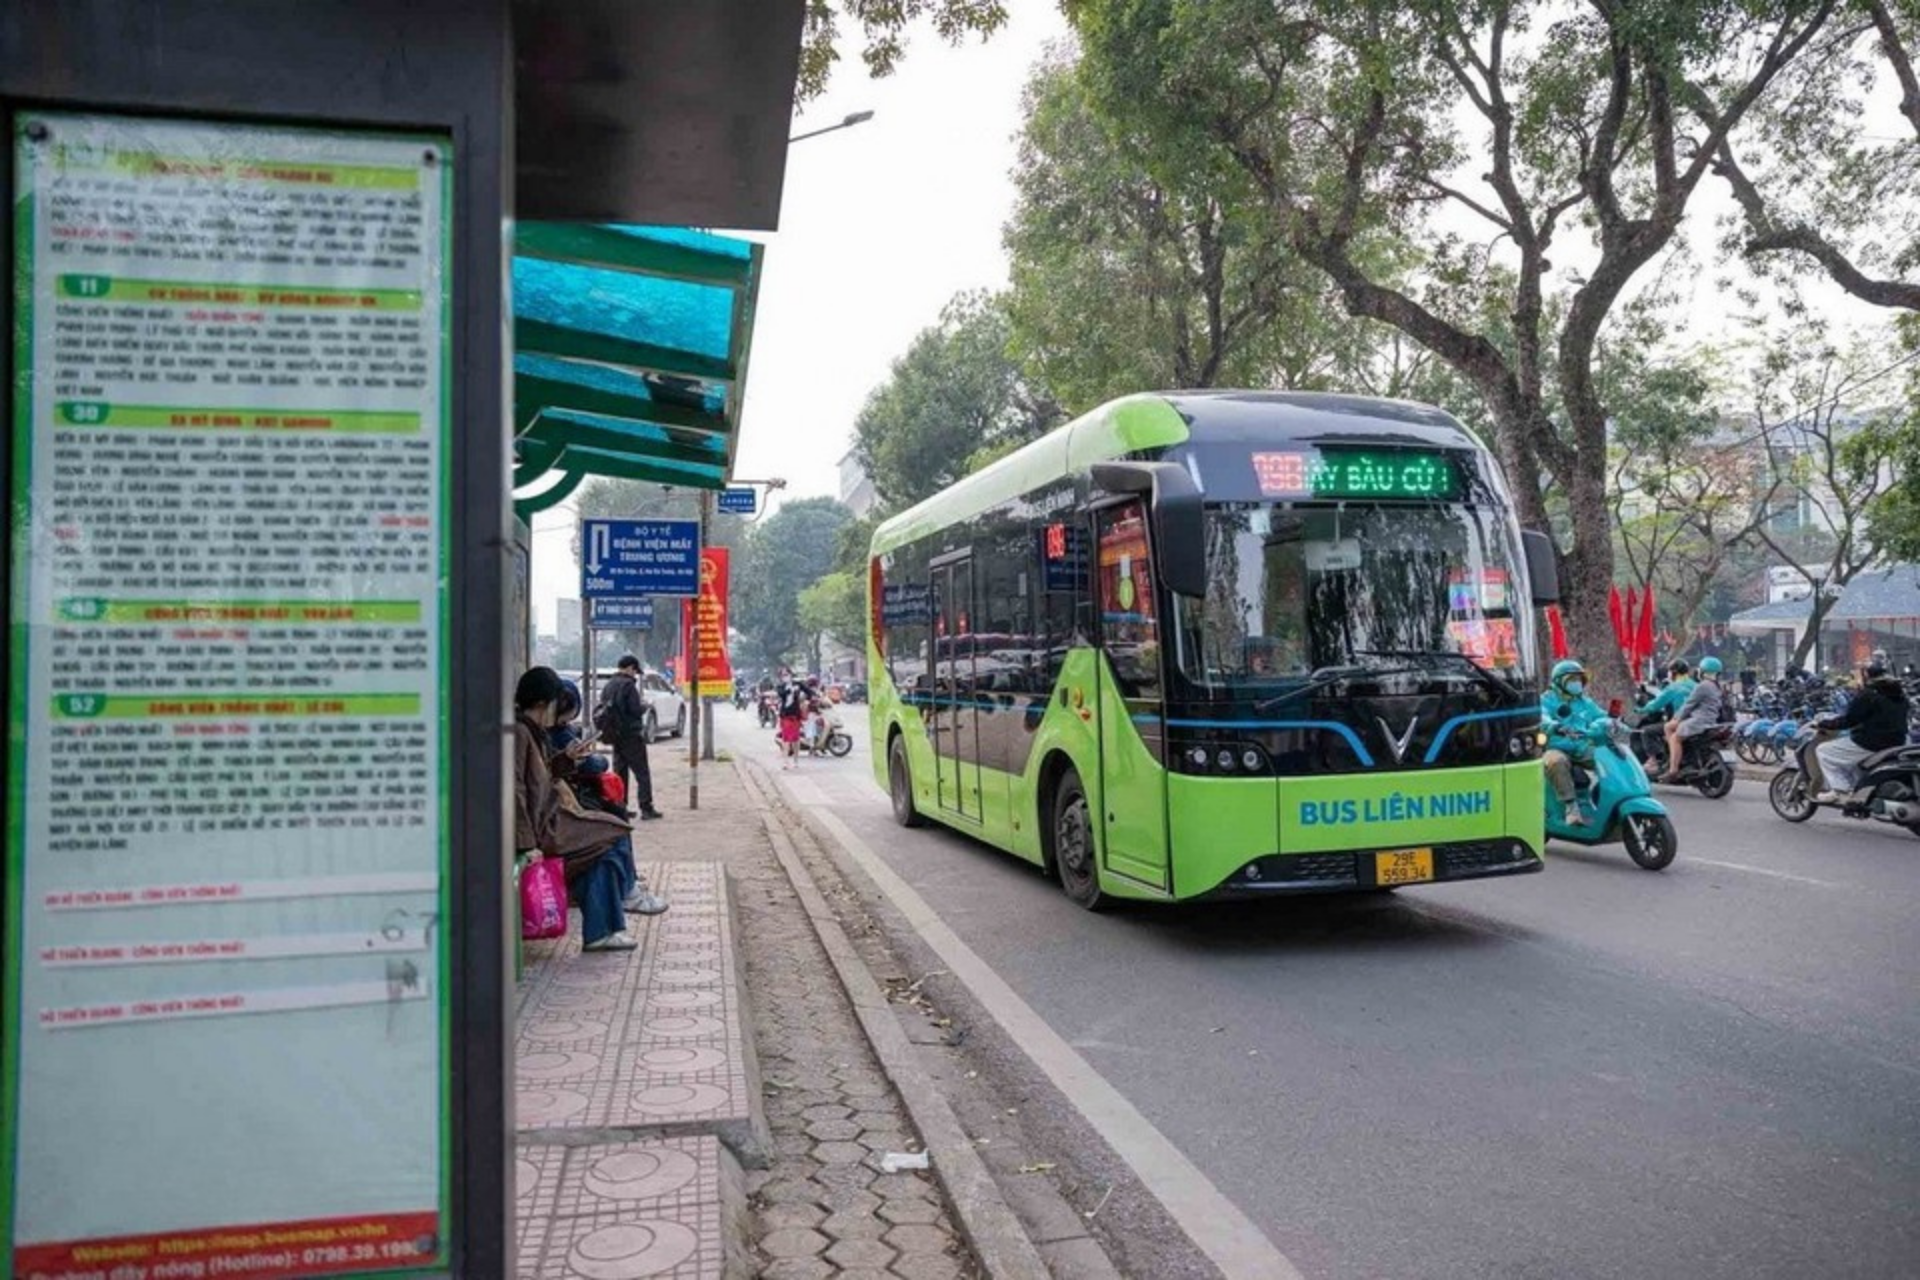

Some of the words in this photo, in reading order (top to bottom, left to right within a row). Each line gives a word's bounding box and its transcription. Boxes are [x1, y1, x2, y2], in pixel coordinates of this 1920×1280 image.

[80, 279, 97, 293] 11
[1347, 456, 1394, 491] BẦU
[1401, 457, 1436, 491] CỬ
[1300, 799, 1358, 826] BUS
[1364, 791, 1425, 823] LIÊN
[1430, 791, 1491, 818] NINH
[1393, 851, 1417, 866] 29E
[1383, 867, 1427, 884] 559.34
